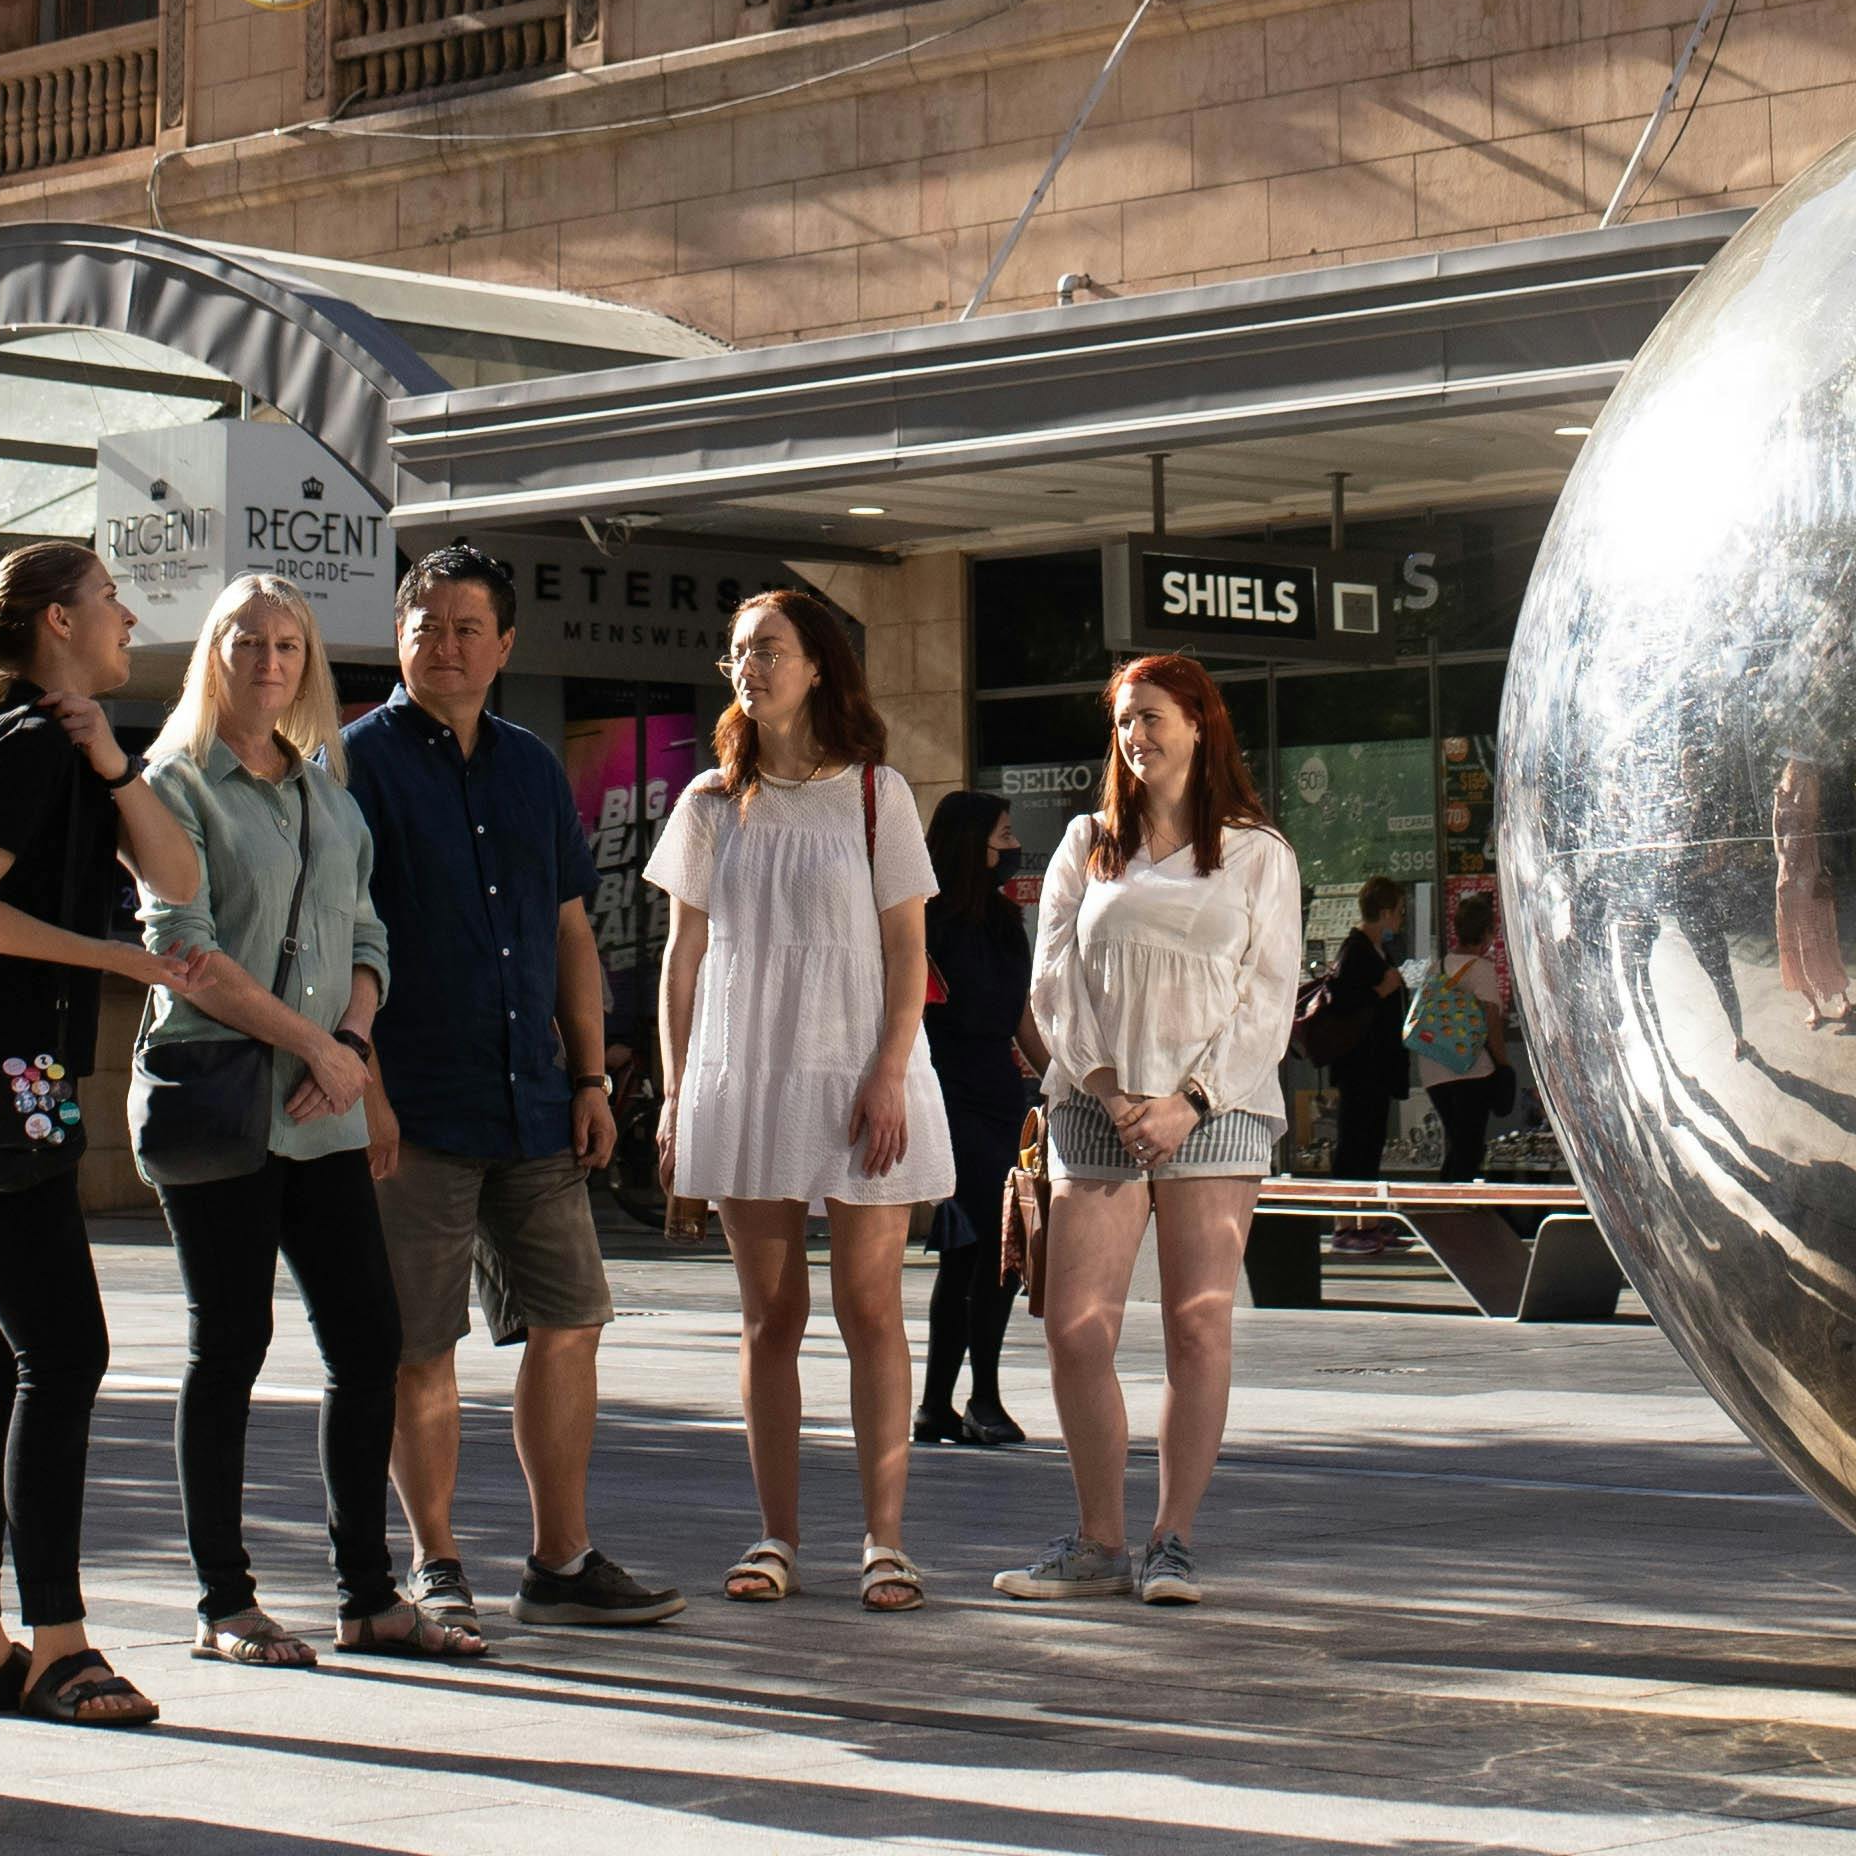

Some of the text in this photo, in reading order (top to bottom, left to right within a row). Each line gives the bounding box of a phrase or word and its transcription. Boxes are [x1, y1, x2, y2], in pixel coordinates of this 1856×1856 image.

[107, 507, 212, 559] REGENT
[245, 506, 384, 557] REGENT
[275, 558, 350, 583] ARCADE
[1161, 570, 1300, 624] SHIELS
[1002, 765, 1092, 795] SEIKO
[1390, 849, 1436, 872] $399
